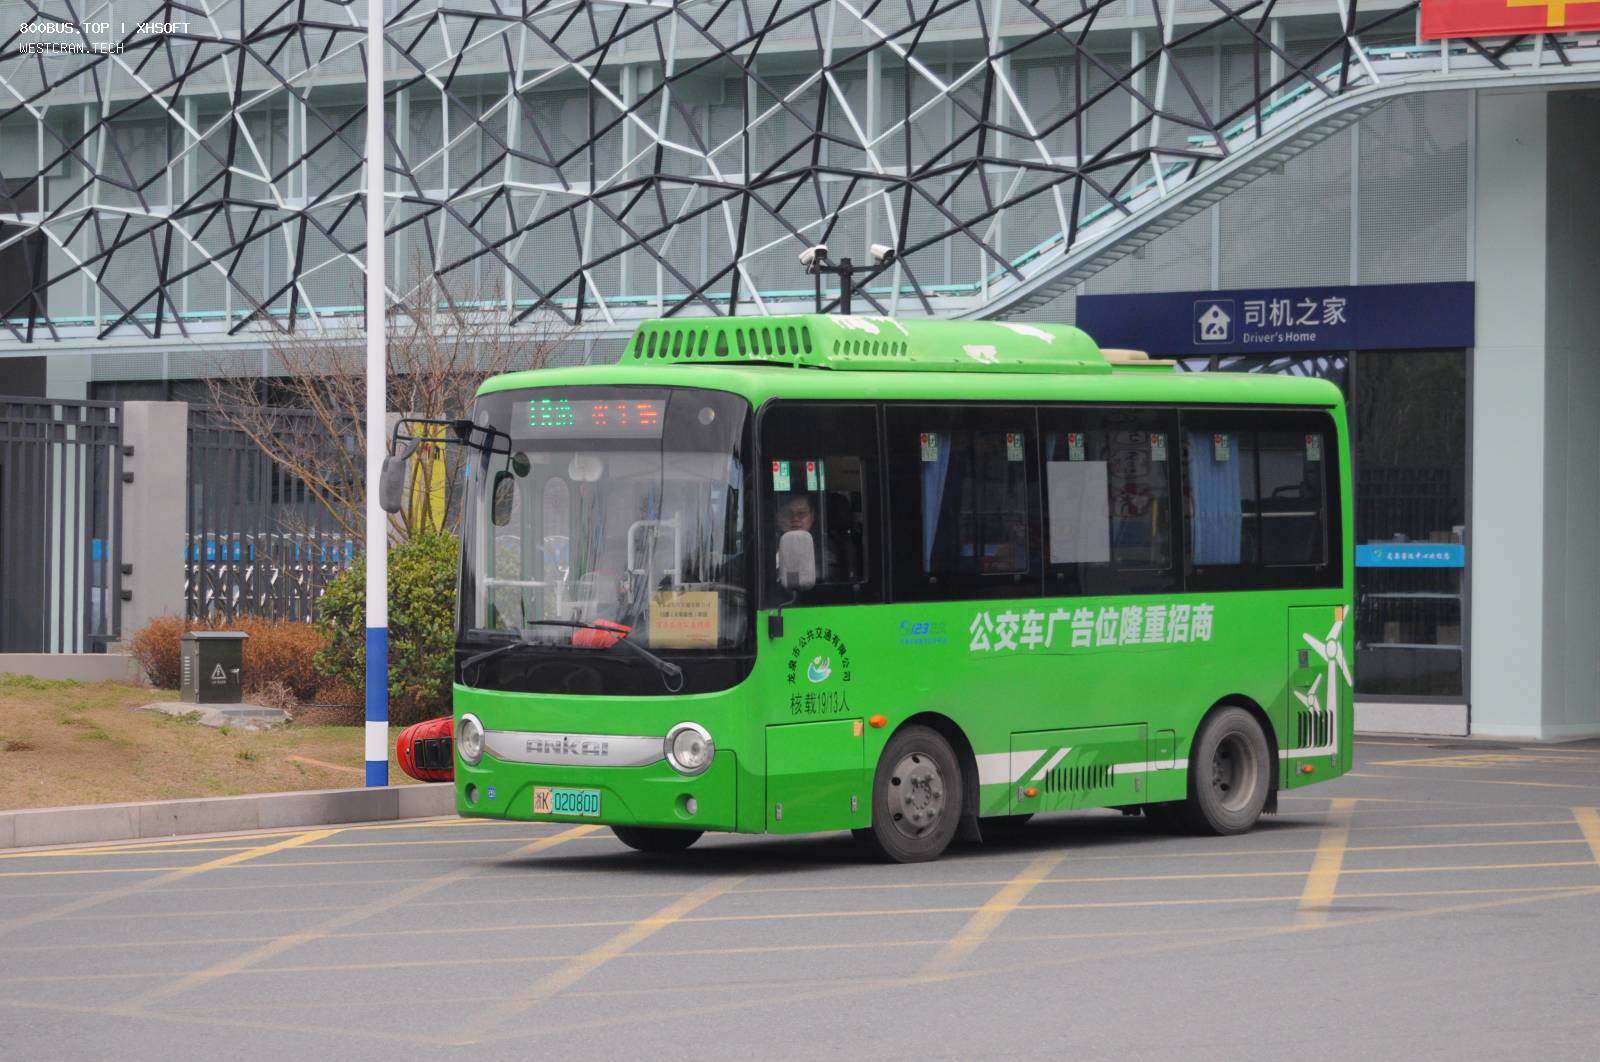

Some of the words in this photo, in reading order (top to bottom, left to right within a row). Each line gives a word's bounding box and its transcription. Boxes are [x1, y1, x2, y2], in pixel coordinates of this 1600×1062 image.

[1243, 297, 1347, 327] 司机之家
[1243, 331, 1284, 343] Driver's
[1285, 332, 1317, 342] Home
[968, 602, 1215, 653] 公交车广告位隆重招商
[526, 738, 609, 757] ANKAI
